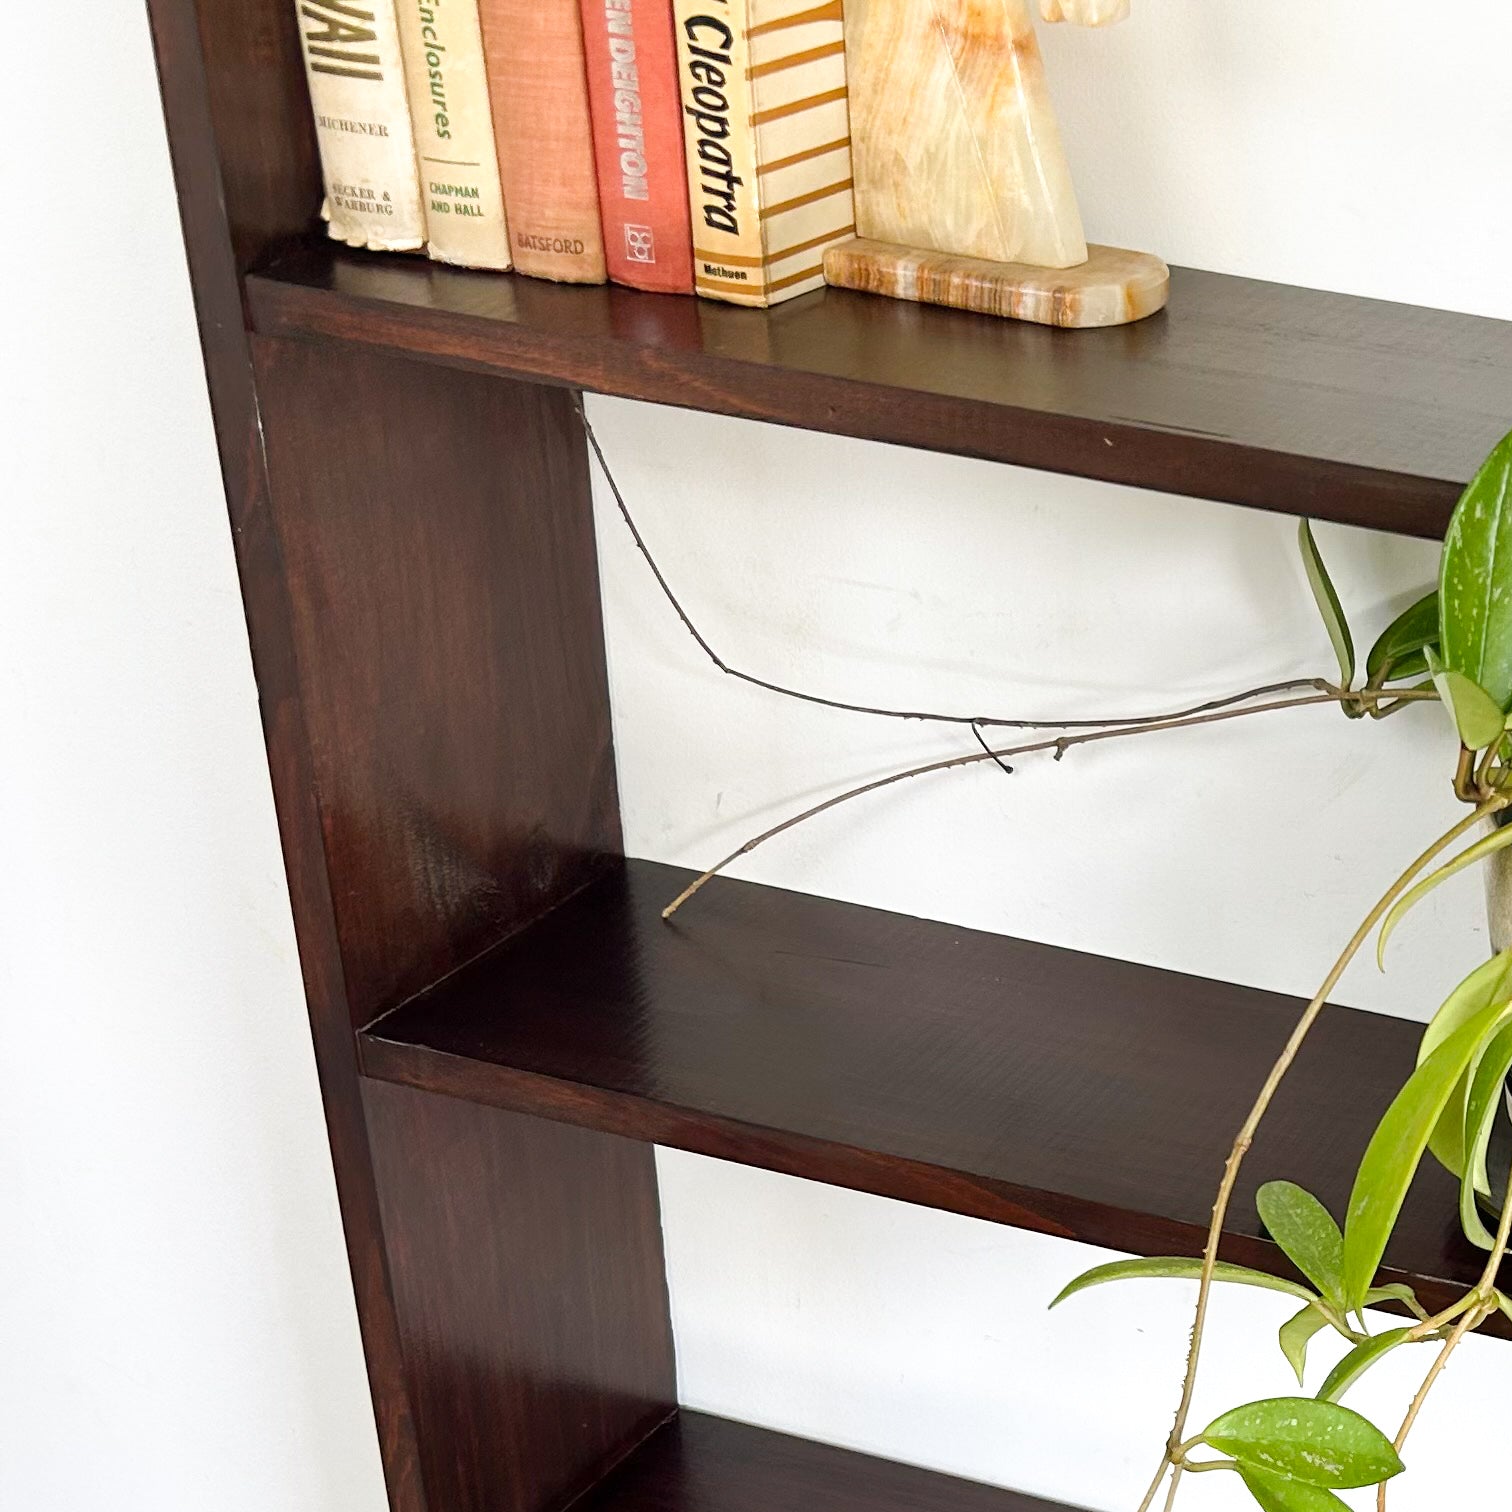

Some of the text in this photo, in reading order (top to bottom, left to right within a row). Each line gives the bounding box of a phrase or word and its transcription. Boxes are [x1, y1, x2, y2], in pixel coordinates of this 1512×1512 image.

[318, 115, 390, 137] MICHENER
[608, 37, 648, 201] DEIGHTON
[683, 15, 744, 236] Cleopatra
[382, 190, 392, 202] &
[429, 182, 480, 199] CHAPMAN
[431, 201, 485, 217] AND HALL
[517, 232, 584, 256] BATSFORD
